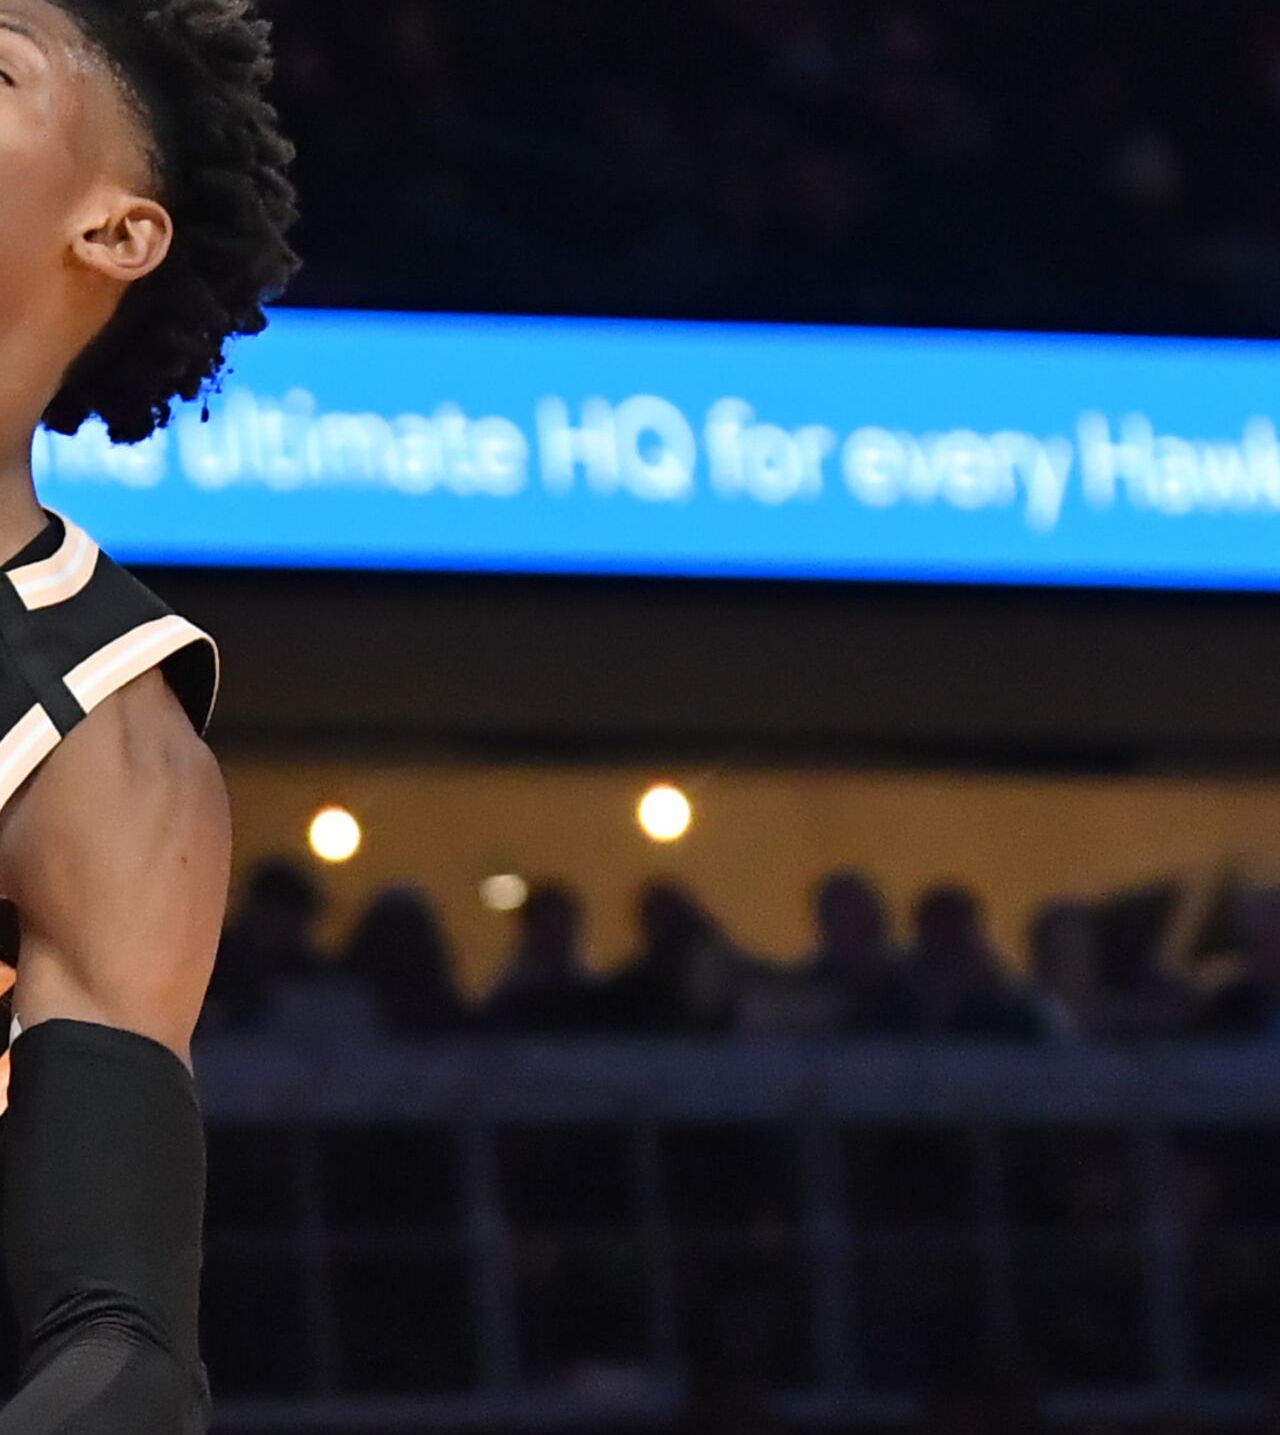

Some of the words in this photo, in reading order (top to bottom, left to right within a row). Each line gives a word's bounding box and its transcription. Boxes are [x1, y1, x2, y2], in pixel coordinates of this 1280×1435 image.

[537, 394, 696, 503] HQ
[704, 397, 836, 506] for
[843, 426, 1072, 535] every
